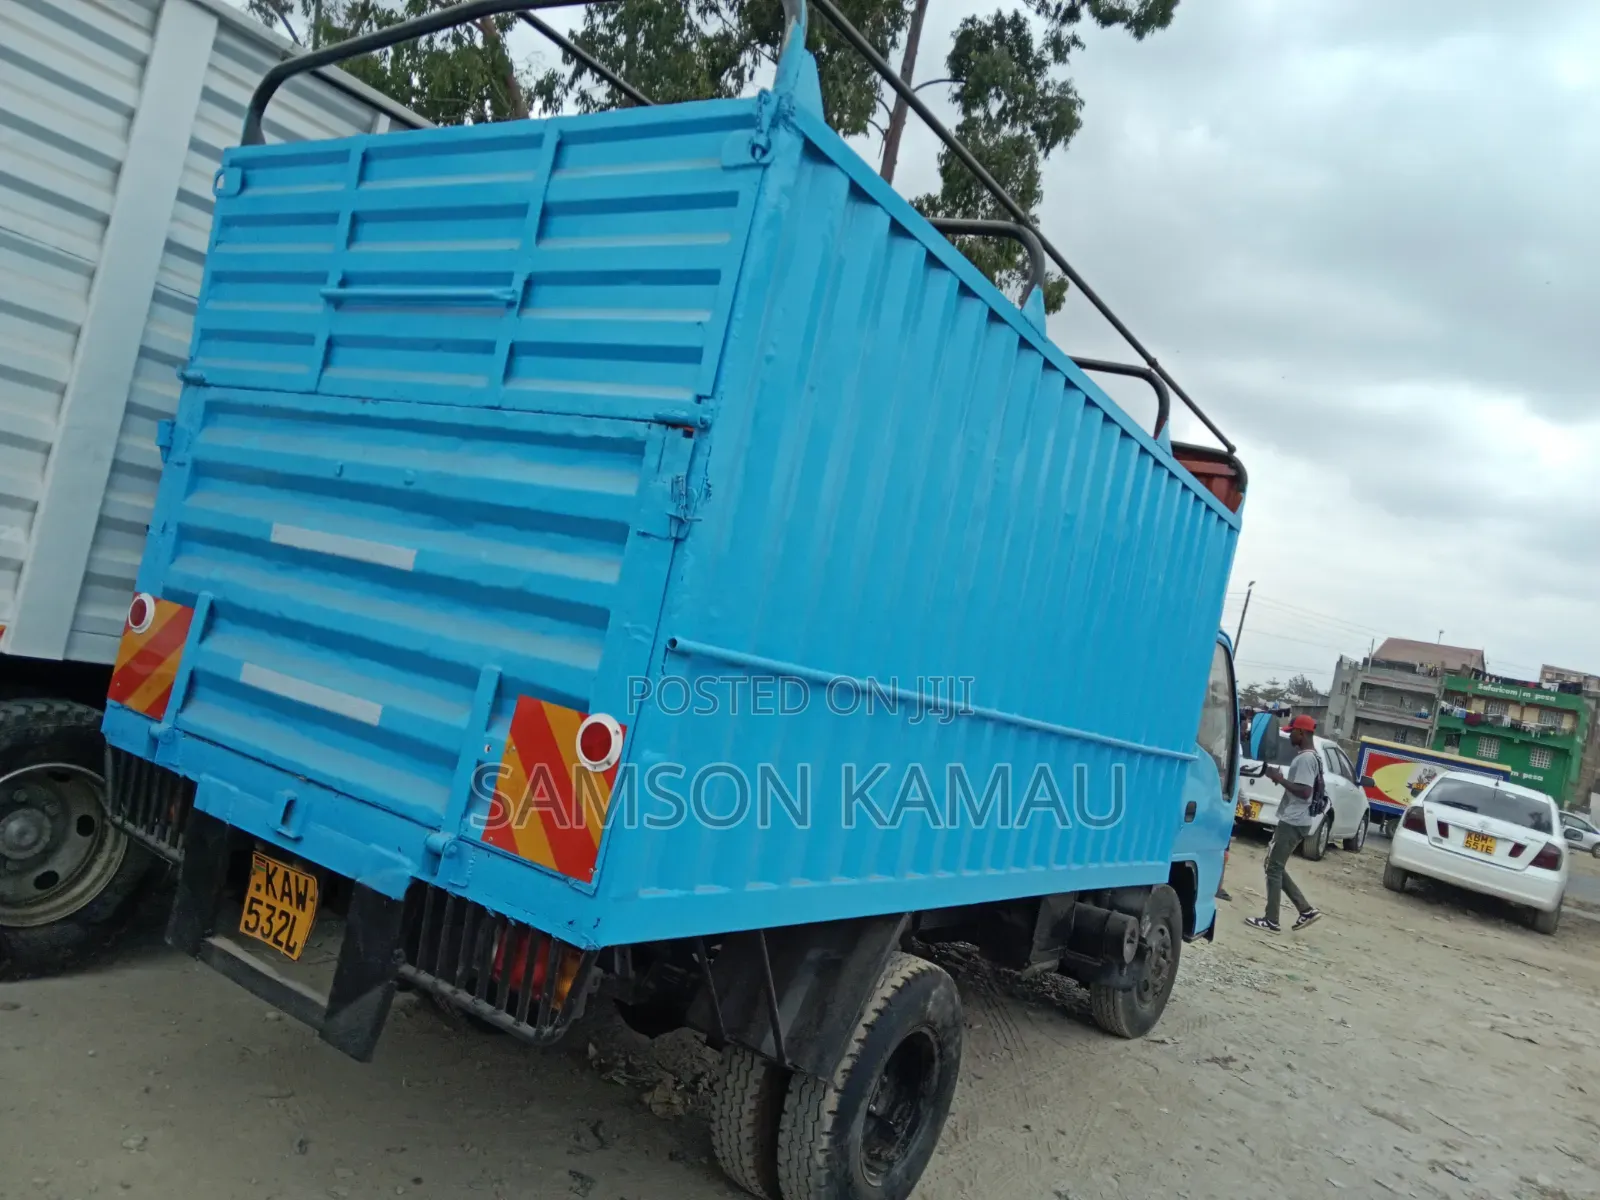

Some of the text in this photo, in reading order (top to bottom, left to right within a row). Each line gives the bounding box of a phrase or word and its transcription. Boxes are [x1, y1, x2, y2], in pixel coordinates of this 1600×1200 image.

[1477, 683, 1518, 696] Safaricom
[265, 862, 309, 912] KAW
[244, 896, 298, 954] 532L
